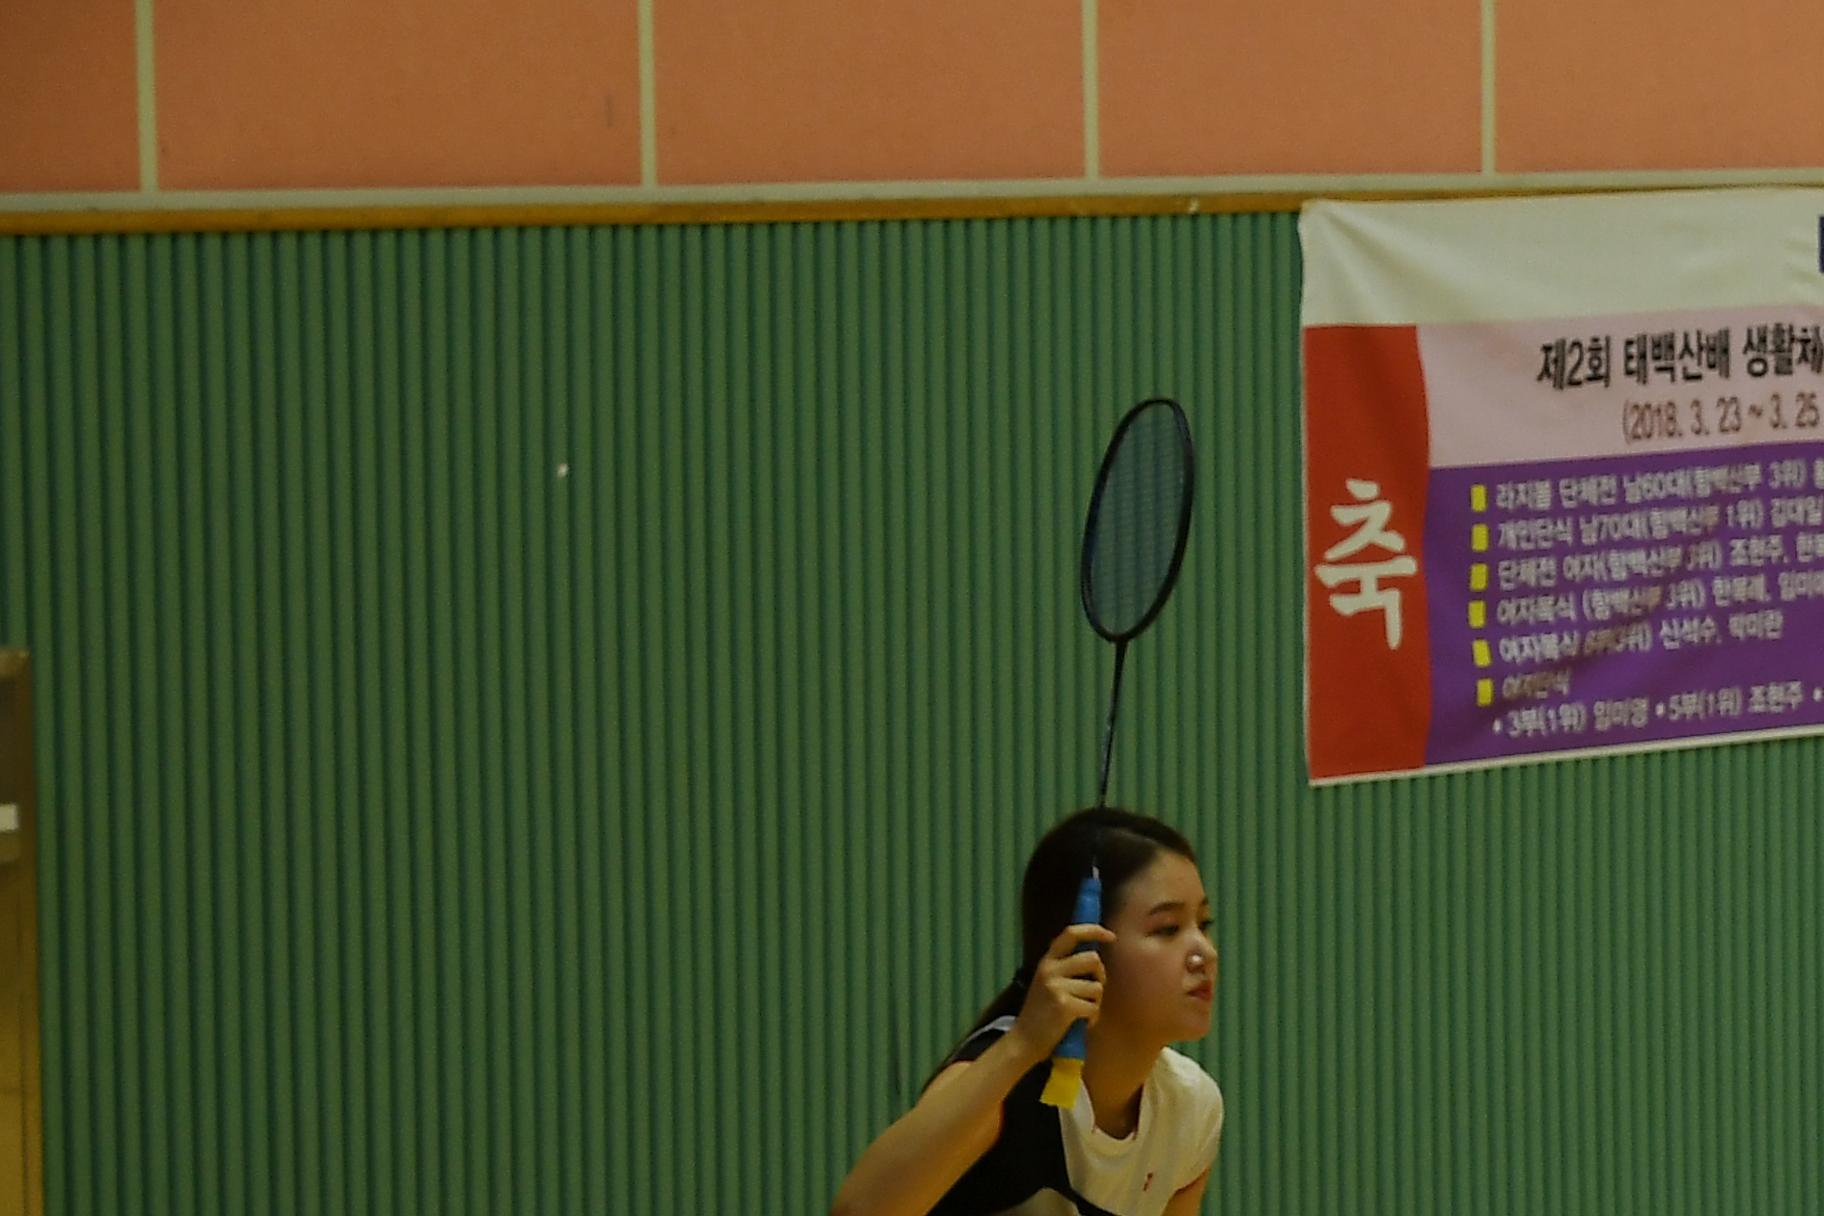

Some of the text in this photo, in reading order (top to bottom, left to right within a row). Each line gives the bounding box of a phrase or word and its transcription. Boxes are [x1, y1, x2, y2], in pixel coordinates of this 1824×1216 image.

[1537, 336, 1612, 390] 제2회
[1624, 328, 1730, 384] 태백산배
[1313, 478, 1417, 650] 축
